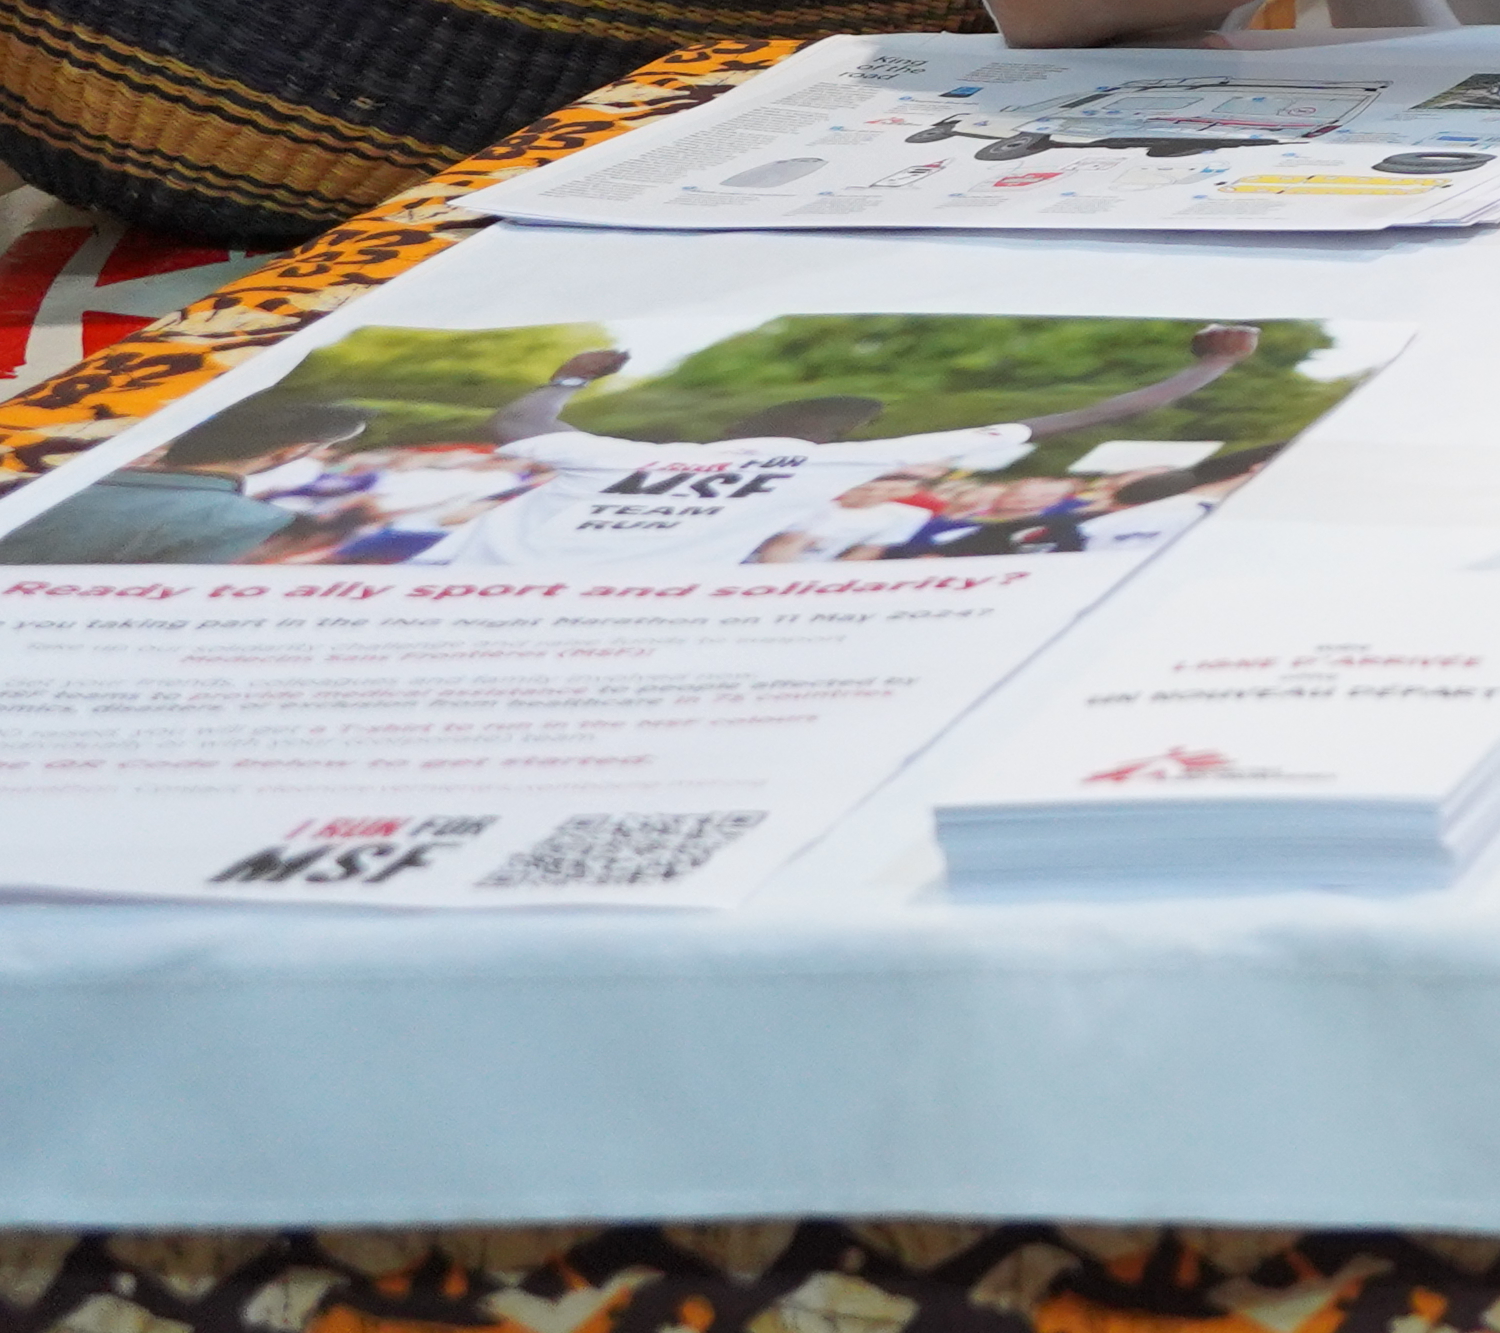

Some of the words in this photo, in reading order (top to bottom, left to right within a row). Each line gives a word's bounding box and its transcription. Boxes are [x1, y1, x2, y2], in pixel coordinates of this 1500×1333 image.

[590, 504, 726, 516] TEAM
[575, 519, 682, 530] RUN
[1, 580, 193, 601] Ready
[207, 584, 271, 599] to
[284, 580, 396, 600] ally
[406, 581, 569, 601] sport
[578, 583, 701, 598] and
[708, 570, 1032, 597] solidarity?
[207, 841, 464, 884] MSF
